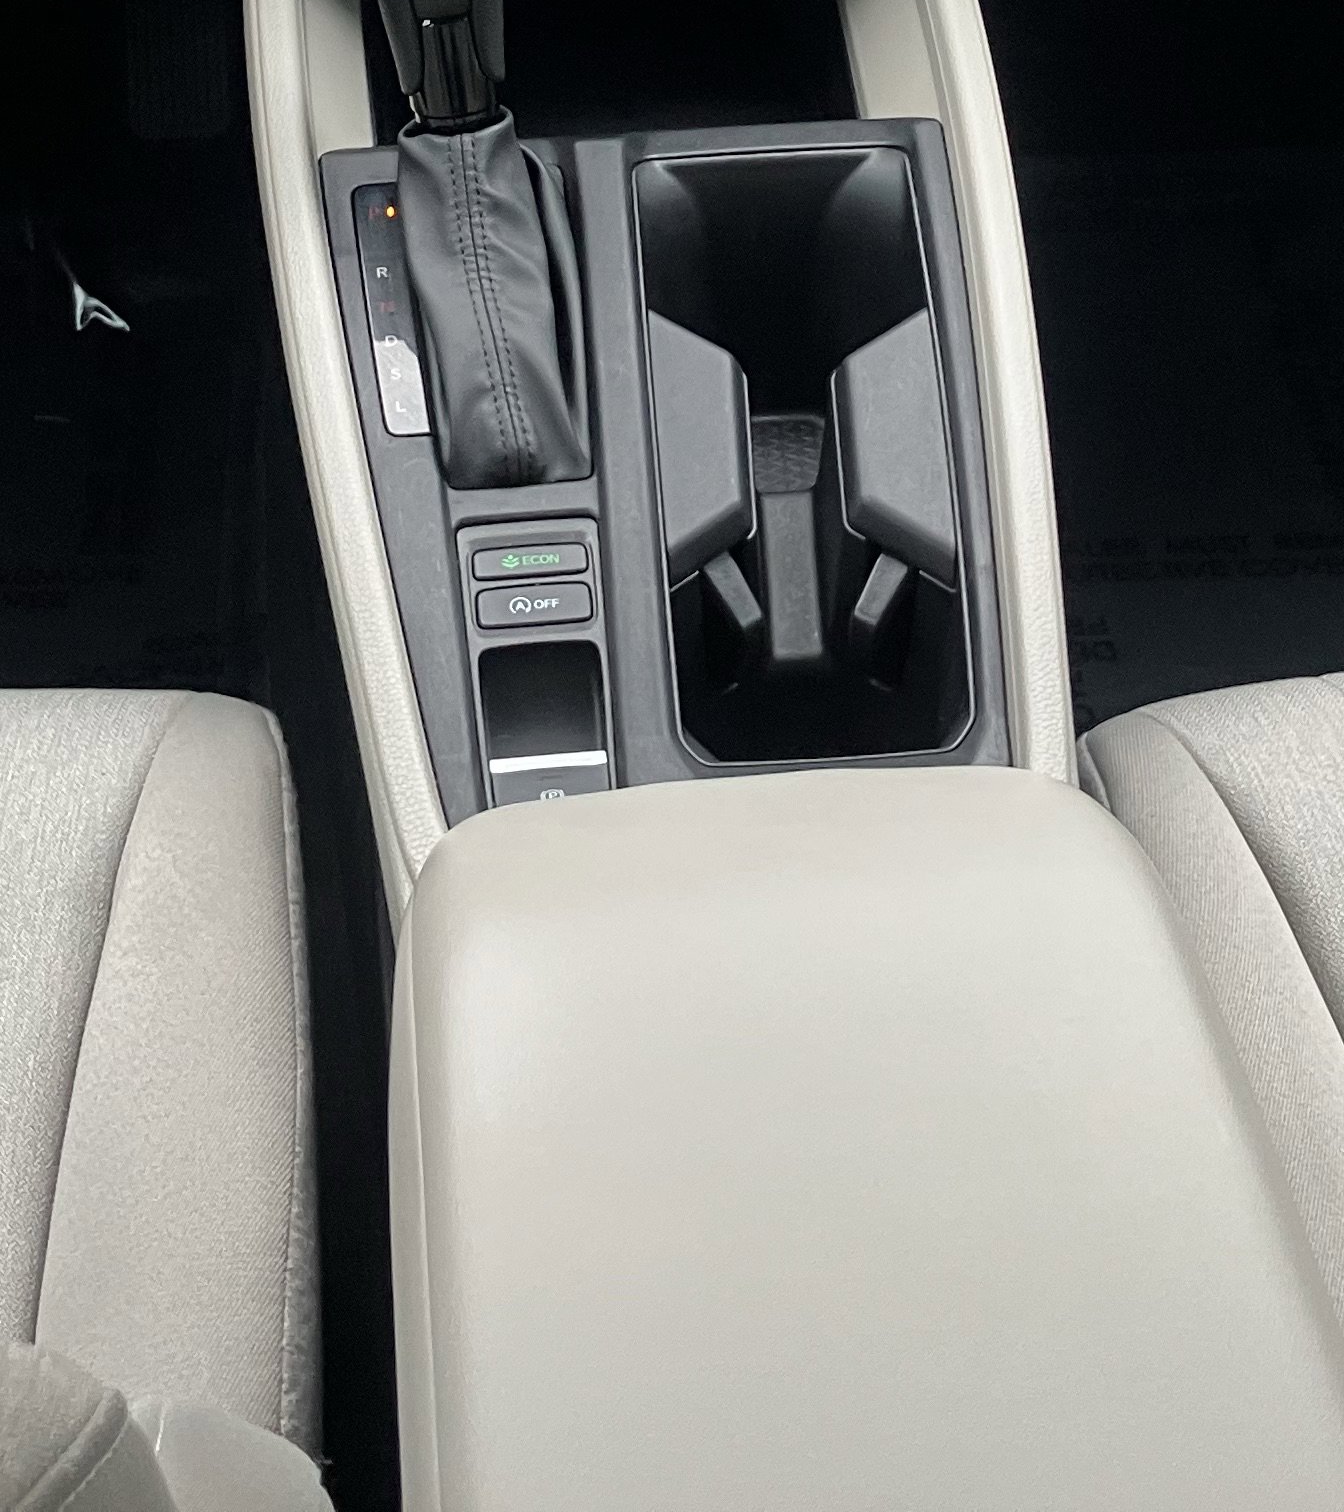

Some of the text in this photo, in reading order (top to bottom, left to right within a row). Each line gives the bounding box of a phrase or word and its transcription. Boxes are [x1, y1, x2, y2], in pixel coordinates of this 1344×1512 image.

[376, 267, 389, 279] R
[385, 335, 398, 348] D
[390, 368, 402, 381] S
[395, 400, 407, 413] L
[522, 554, 560, 565] ECON
[533, 598, 560, 609] OFF
